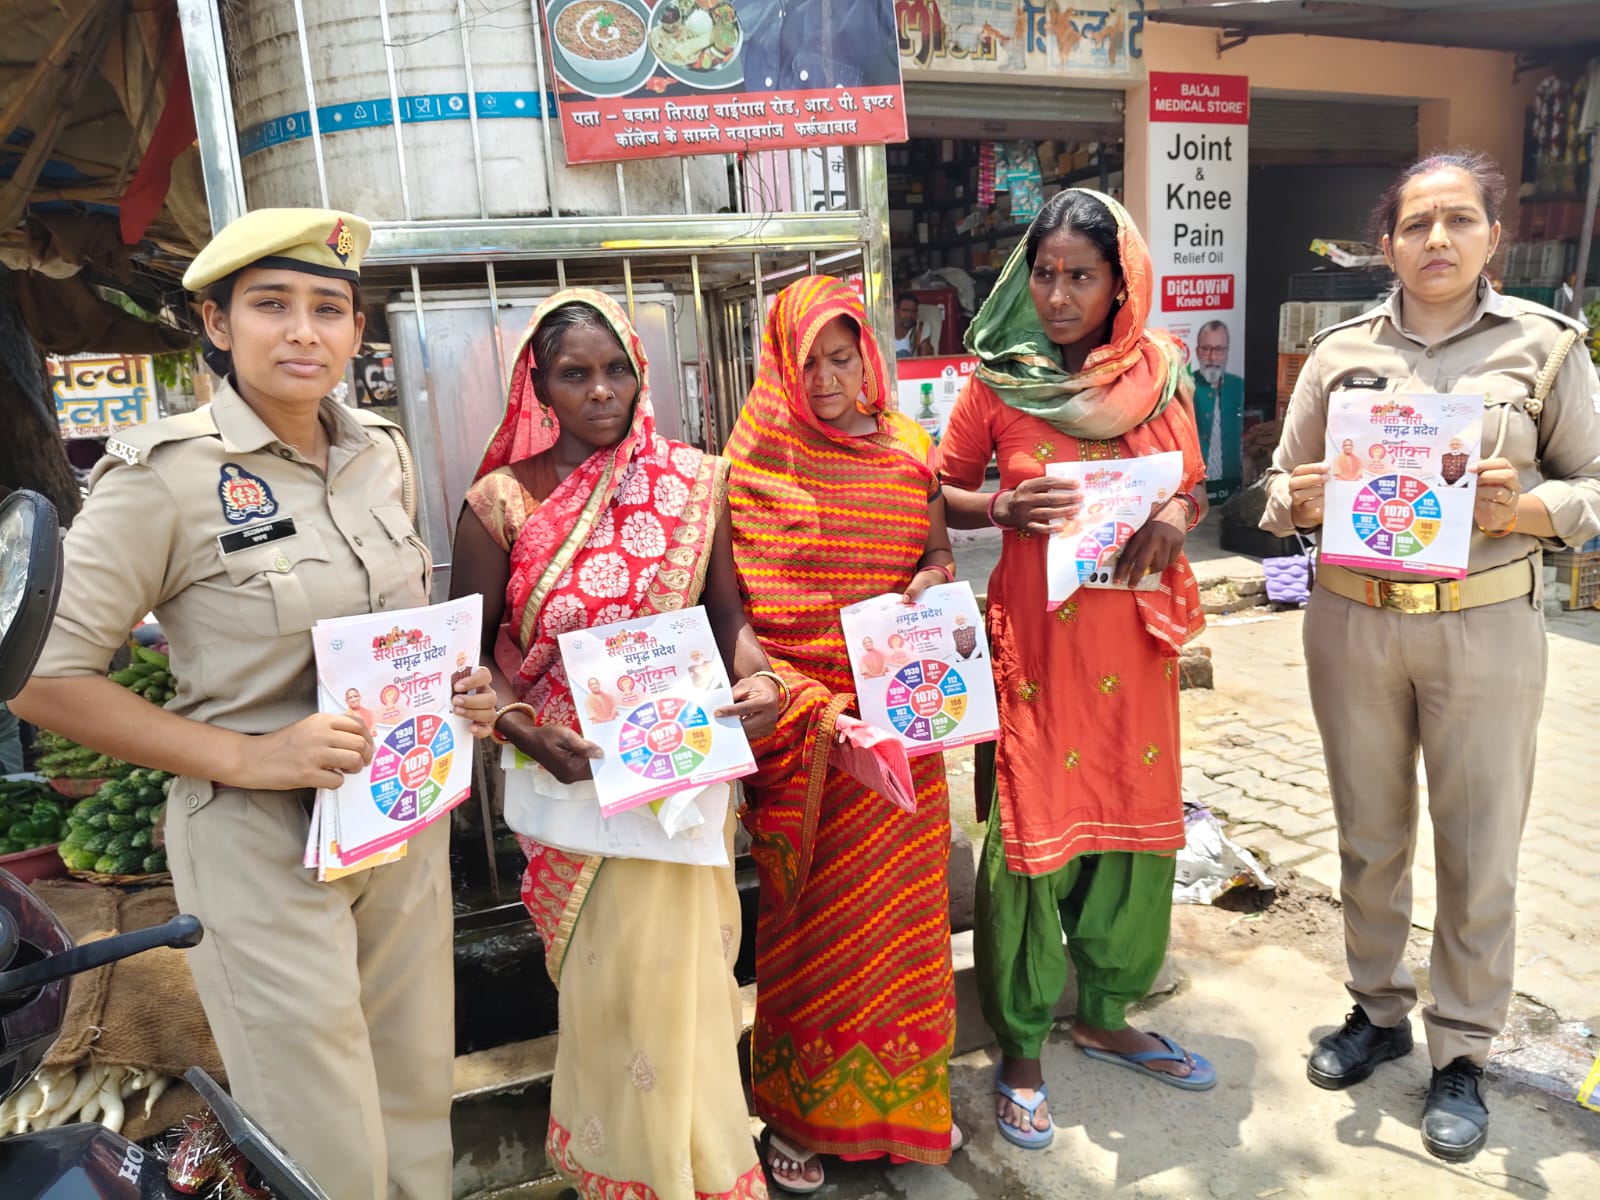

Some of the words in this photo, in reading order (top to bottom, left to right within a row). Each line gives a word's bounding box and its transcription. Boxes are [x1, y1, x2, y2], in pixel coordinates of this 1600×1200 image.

[1181, 83, 1220, 97] BALAJI
[571, 110, 600, 127] पता
[664, 101, 709, 120] तिराहा
[804, 98, 834, 113] आर.
[838, 92, 858, 111] पी.
[1155, 98, 1205, 112] MEDICAL
[1207, 101, 1243, 113] STORE
[615, 127, 660, 148] कॉलेज
[664, 126, 677, 143] के
[682, 124, 720, 144] सामने
[1167, 133, 1232, 161] Joint
[1195, 167, 1205, 180] &
[1167, 183, 1231, 210] Knee
[1174, 223, 1224, 247] Pain
[1174, 252, 1205, 264] Relief
[1208, 252, 1223, 263] Oil
[1176, 296, 1203, 307] Knee
[1205, 295, 1220, 306] Oil
[1384, 425, 1410, 438] समृद्ध
[1413, 423, 1439, 436] प्रदेश
[1383, 504, 1410, 518] 1076
[920, 607, 943, 619] प्रदेश
[373, 644, 409, 661] सशक्त
[412, 635, 431, 652] नारी
[623, 651, 650, 665] समृद्ध
[652, 644, 676, 658] प्रदेश
[392, 653, 421, 671] समृद्ध
[423, 645, 447, 662] प्रदेश
[914, 689, 939, 704] 1076
[395, 727, 413, 740] 1930
[404, 752, 430, 773] 1076
